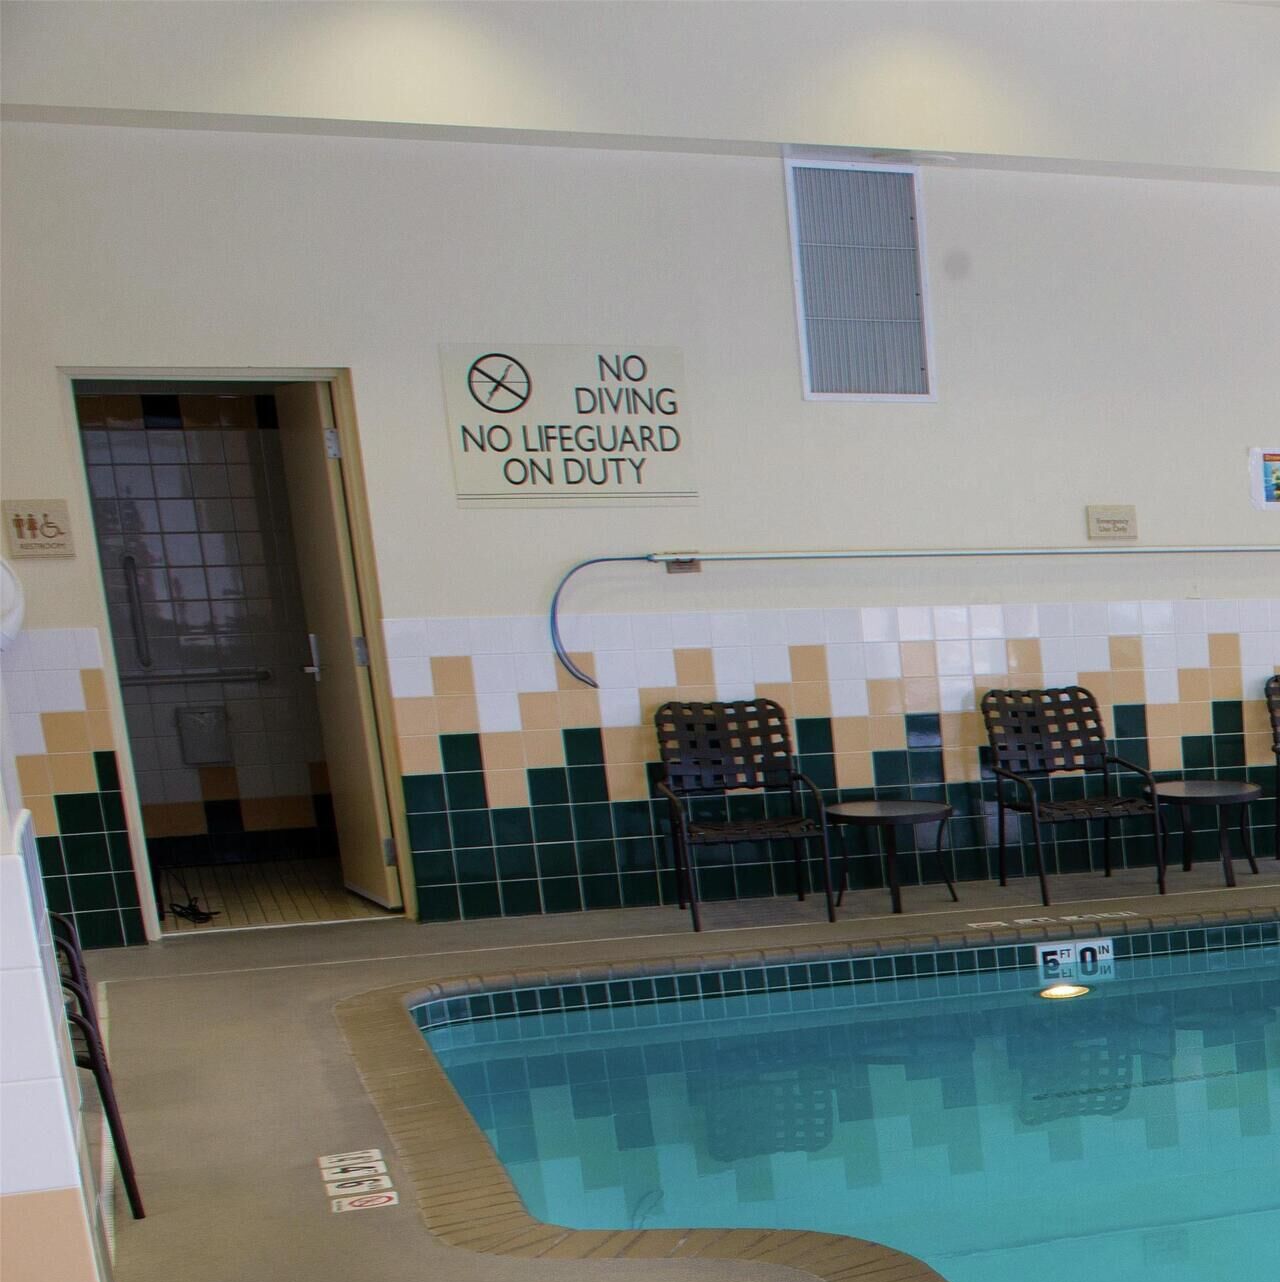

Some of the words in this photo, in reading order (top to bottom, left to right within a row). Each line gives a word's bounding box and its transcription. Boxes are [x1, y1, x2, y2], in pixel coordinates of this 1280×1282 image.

[598, 354, 648, 382] NO
[575, 387, 679, 416] DIVING
[461, 424, 513, 453] NO
[522, 425, 682, 453] LIFEGUARD
[503, 457, 553, 486] ON
[564, 457, 648, 485] DUTY
[1042, 950, 1059, 970] 5
[1060, 949, 1072, 959] FT
[1080, 947, 1098, 968] 0
[1098, 945, 1110, 955] IN
